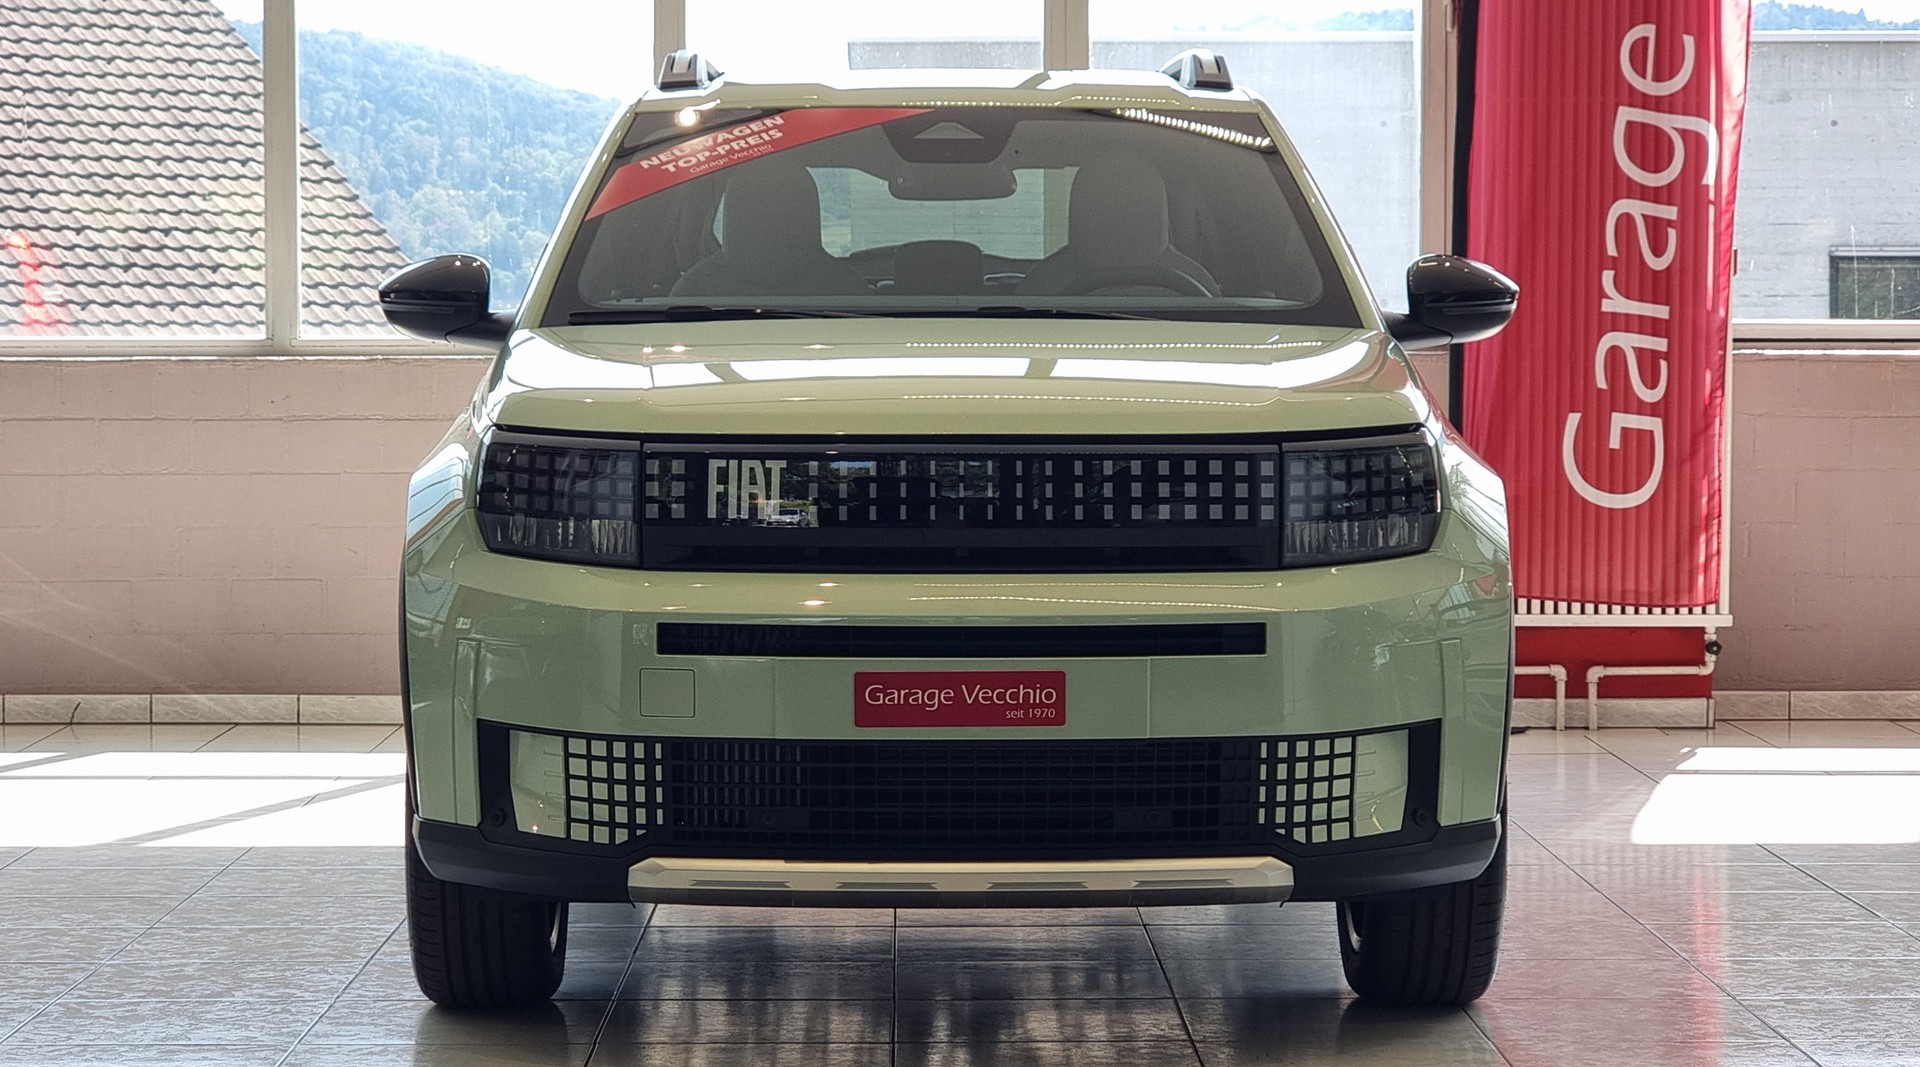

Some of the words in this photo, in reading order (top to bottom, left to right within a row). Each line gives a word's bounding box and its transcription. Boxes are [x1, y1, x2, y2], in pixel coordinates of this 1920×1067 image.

[639, 115, 785, 169] NEUWAGEN
[661, 128, 784, 173] TOP-PREIS
[689, 156, 729, 174] Garage
[729, 143, 772, 160] Vecchio
[1562, 23, 1720, 510] Garage
[707, 459, 787, 520] FIAT
[864, 684, 955, 711] Garage
[961, 683, 1057, 705] Vecchio
[1005, 708, 1024, 719] seit
[1028, 708, 1056, 719] 1970
